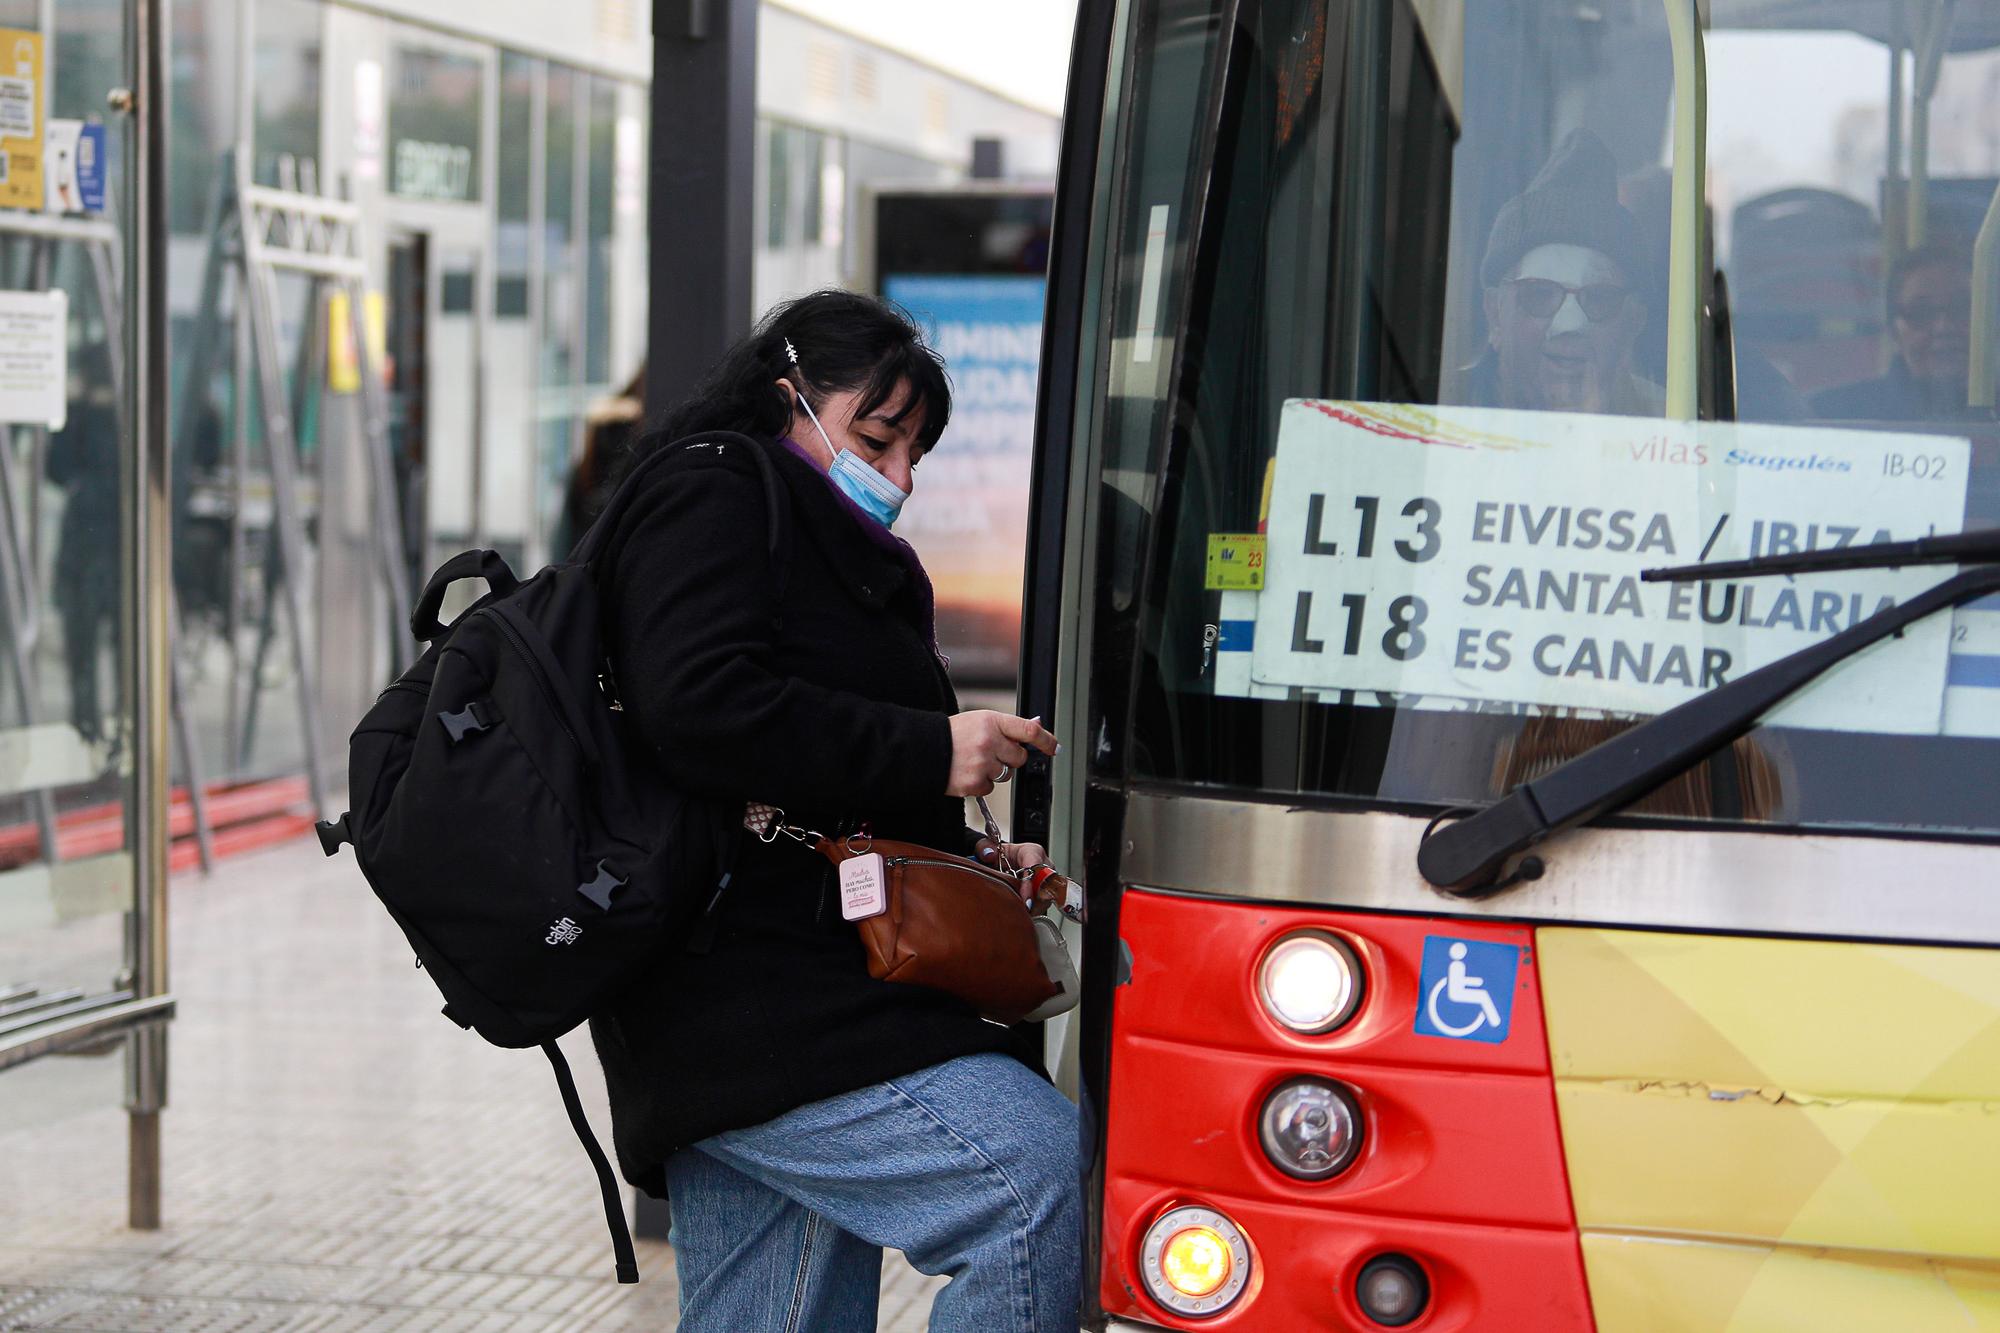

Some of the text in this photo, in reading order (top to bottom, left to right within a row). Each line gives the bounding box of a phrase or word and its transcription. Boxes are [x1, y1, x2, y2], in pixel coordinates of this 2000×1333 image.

[1600, 435, 1710, 466] vilas
[1882, 453, 1947, 480] IB-02
[1303, 493, 1443, 562] L13
[1471, 501, 1677, 555] EIVISSA
[1248, 551, 1262, 568] 23
[1461, 564, 1645, 618] SANTA
[1291, 590, 1733, 689] L18 ES CANAR
[545, 917, 576, 945] cabin
[560, 926, 583, 945] zero
